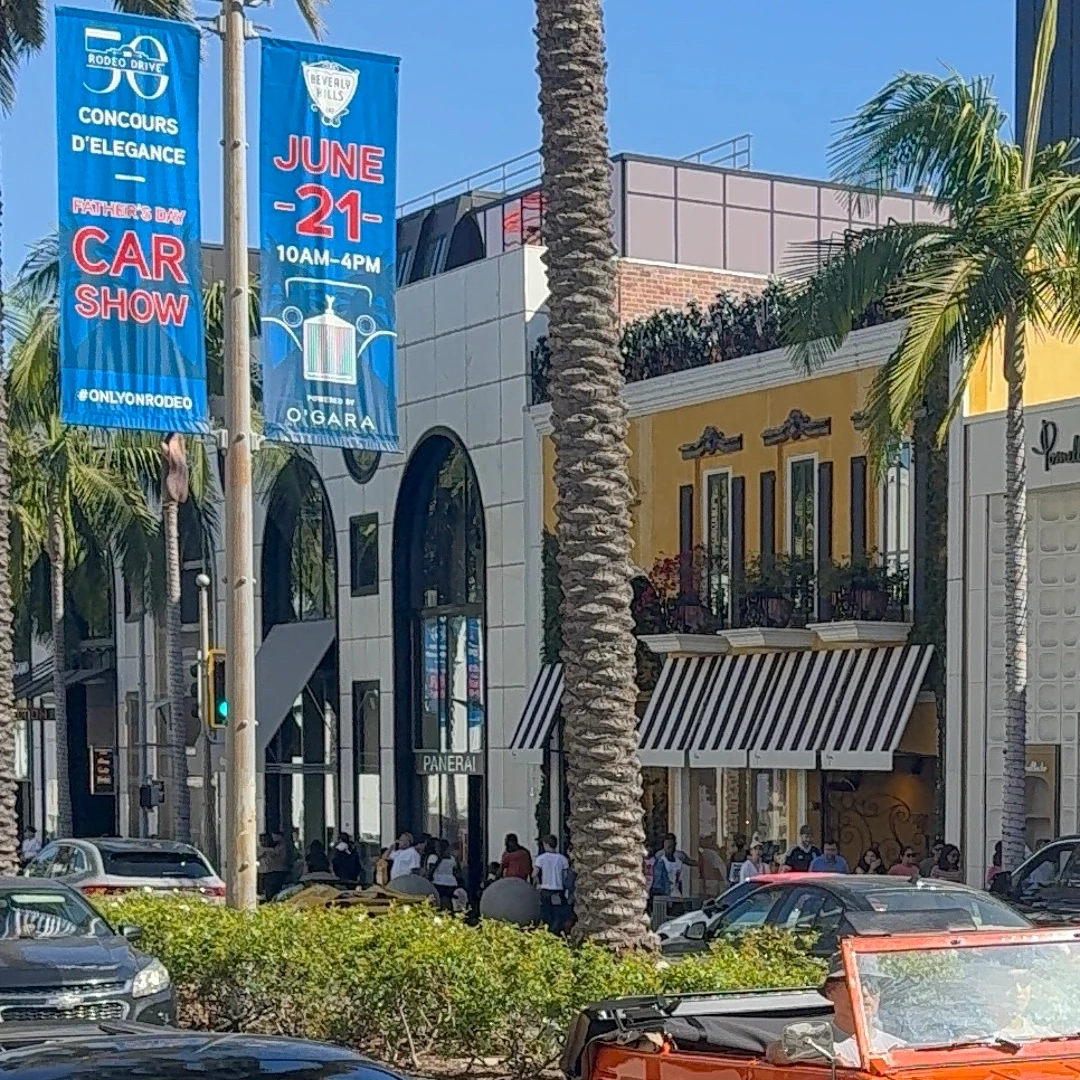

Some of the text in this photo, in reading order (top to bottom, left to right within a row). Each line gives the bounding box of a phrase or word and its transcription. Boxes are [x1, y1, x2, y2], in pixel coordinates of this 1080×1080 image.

[88, 53, 166, 73] RODEO DRIVE
[310, 73, 351, 90] BEVERLY
[316, 86, 344, 102] HILLS
[78, 106, 179, 135] CONCOURS
[71, 134, 187, 165] D'ELEGANCE
[273, 134, 385, 184] JUNE
[72, 197, 187, 226] FATHER'S DAY
[72, 225, 189, 284] CAR
[75, 283, 189, 327] SHOW
[76, 388, 193, 410] #ONLYONRODEO
[286, 407, 376, 430] O'GARA
[423, 755, 476, 773] PANERAI
